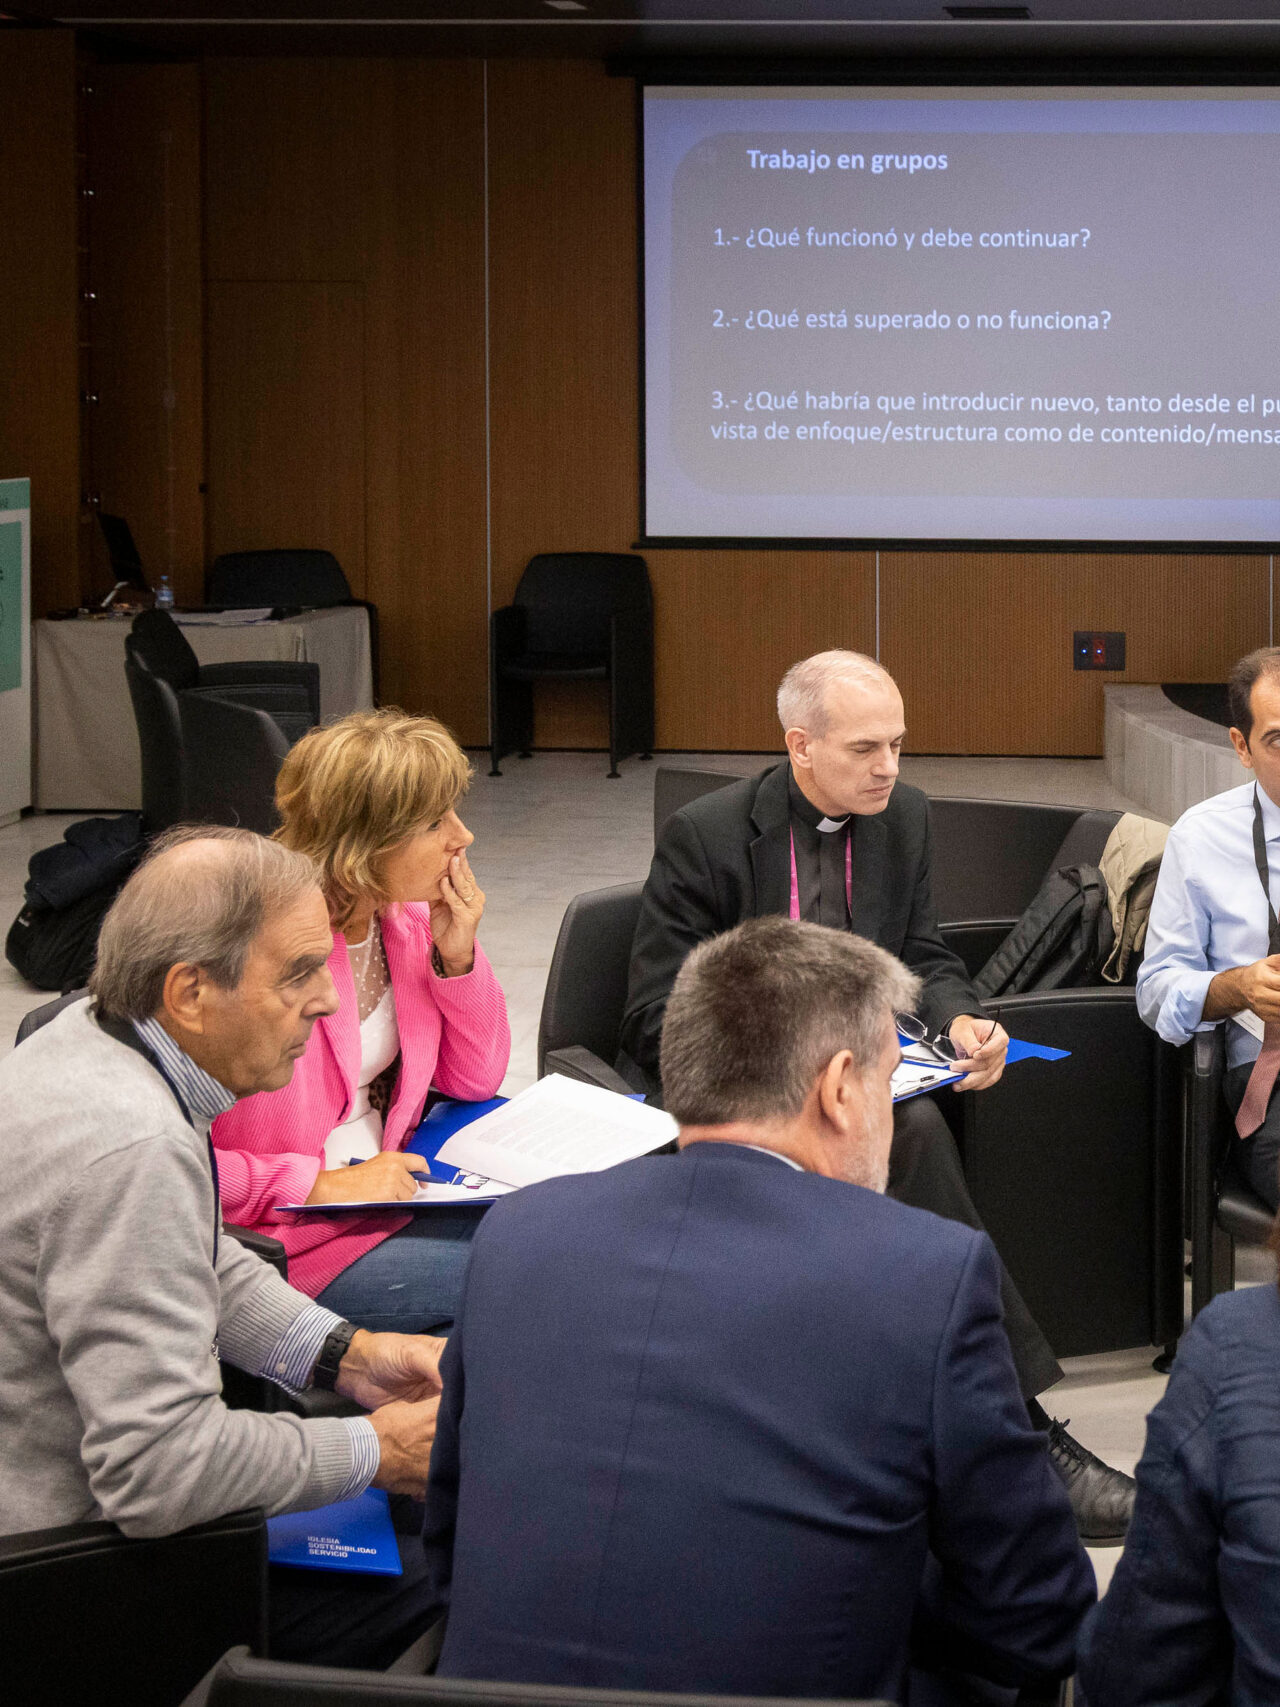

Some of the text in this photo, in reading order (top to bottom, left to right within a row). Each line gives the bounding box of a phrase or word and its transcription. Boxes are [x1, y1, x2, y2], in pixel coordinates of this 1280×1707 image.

[746, 149, 948, 174] Trabajo en grupos
[714, 226, 1091, 251] 1.- ¿Qué funcionó y debe continuar?
[712, 309, 1112, 333] 2.- ¿Qué está superado o no funciona?
[711, 391, 737, 409] 3.-
[744, 391, 798, 414] ¿Qué
[806, 391, 870, 410] habría
[877, 396, 916, 415] que
[923, 391, 1024, 412] introducir
[1031, 397, 1100, 415] nuevo,
[1106, 395, 1162, 412] tanto
[1168, 393, 1231, 413] desde
[1237, 393, 1255, 413] el
[710, 422, 757, 441] vista
[764, 421, 790, 441] de
[796, 420, 998, 446] enfoque/estructura
[1004, 427, 1062, 442] como
[1068, 423, 1094, 443] de
[307, 1536, 340, 1544] IGLESIA
[308, 1542, 377, 1555] SOSTENIBILIDAD
[309, 1548, 348, 1558] SERVICIO
